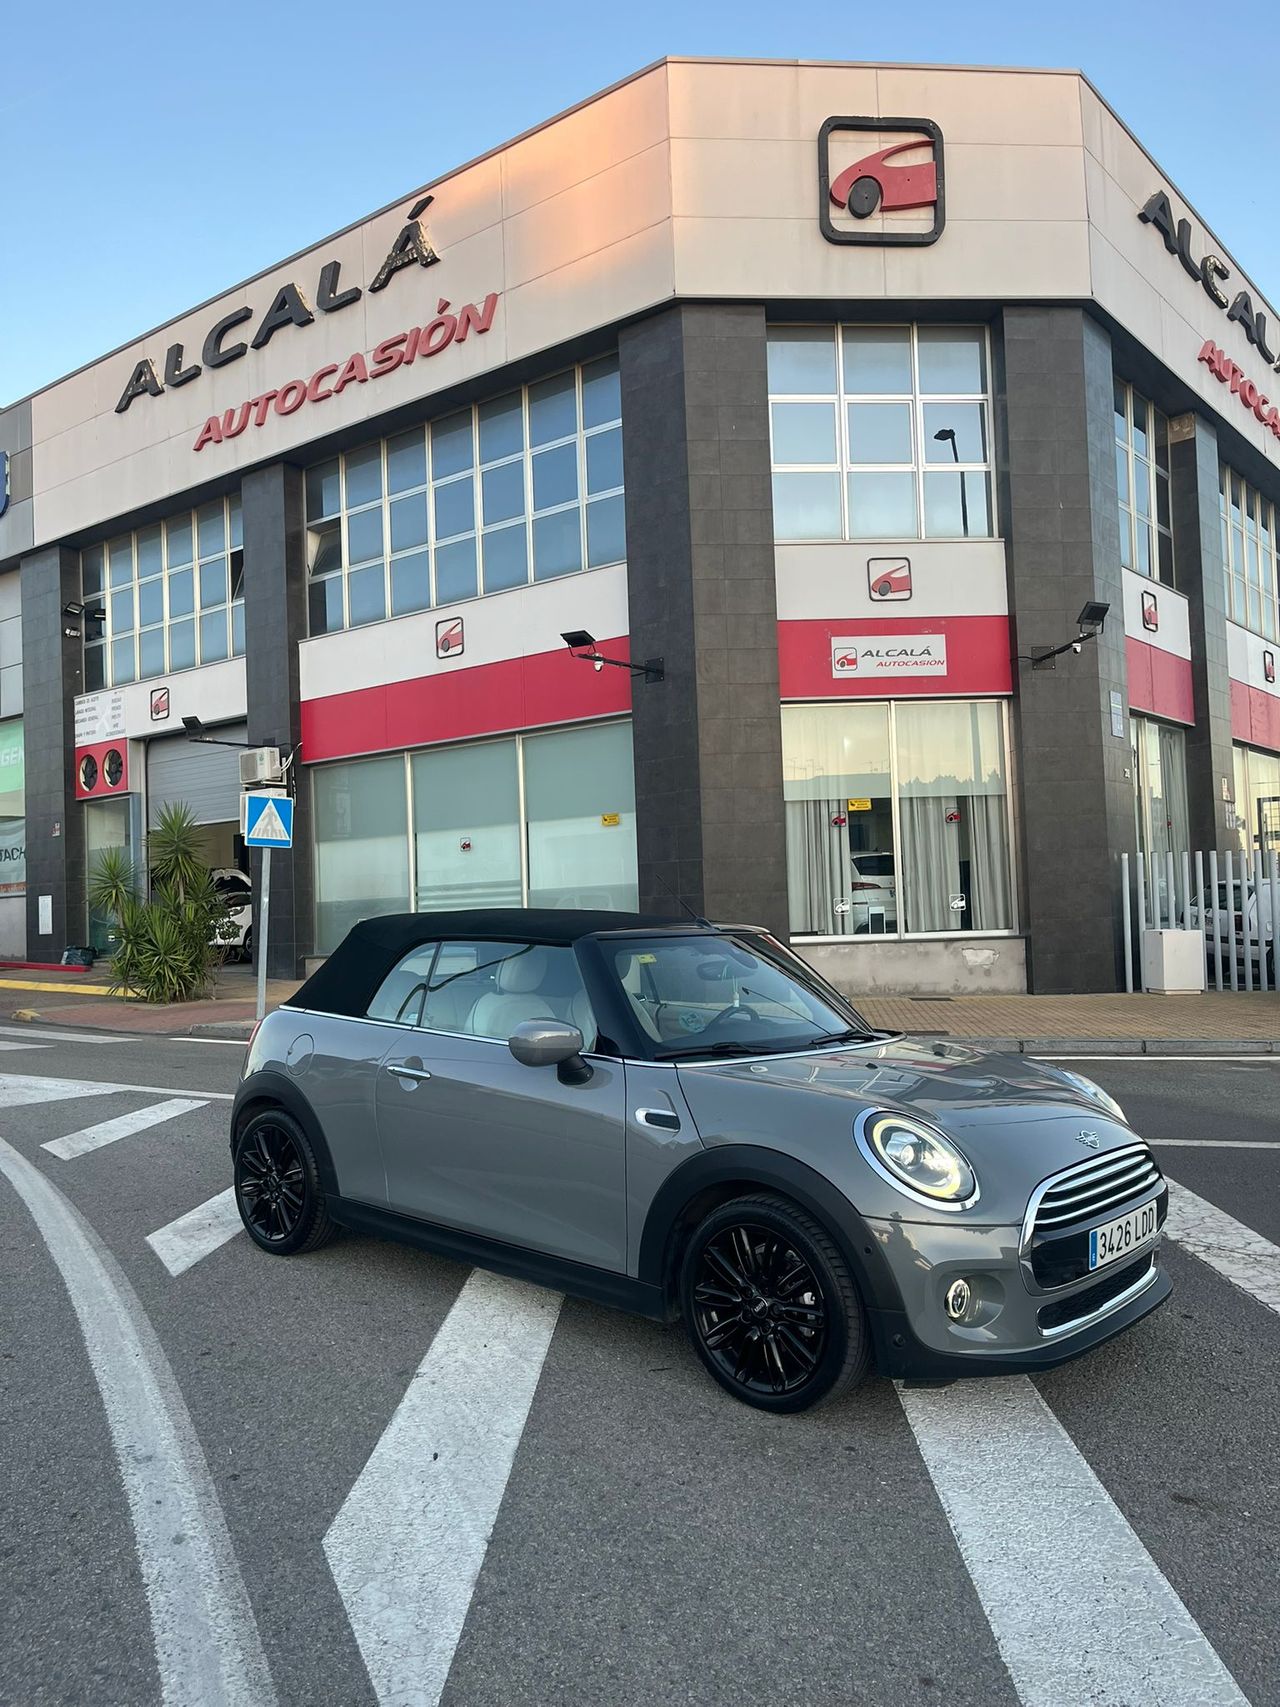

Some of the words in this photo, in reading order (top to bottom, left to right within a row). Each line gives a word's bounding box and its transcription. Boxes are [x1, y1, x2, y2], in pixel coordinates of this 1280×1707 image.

[115, 195, 440, 413] ALCALÁ
[1137, 190, 1280, 374] ALCAL
[193, 292, 498, 451] AUTOCASIÓN
[861, 645, 932, 658] ALCALÁ
[1100, 1221, 1131, 1259] 3426
[1135, 1207, 1154, 1241] LDD
